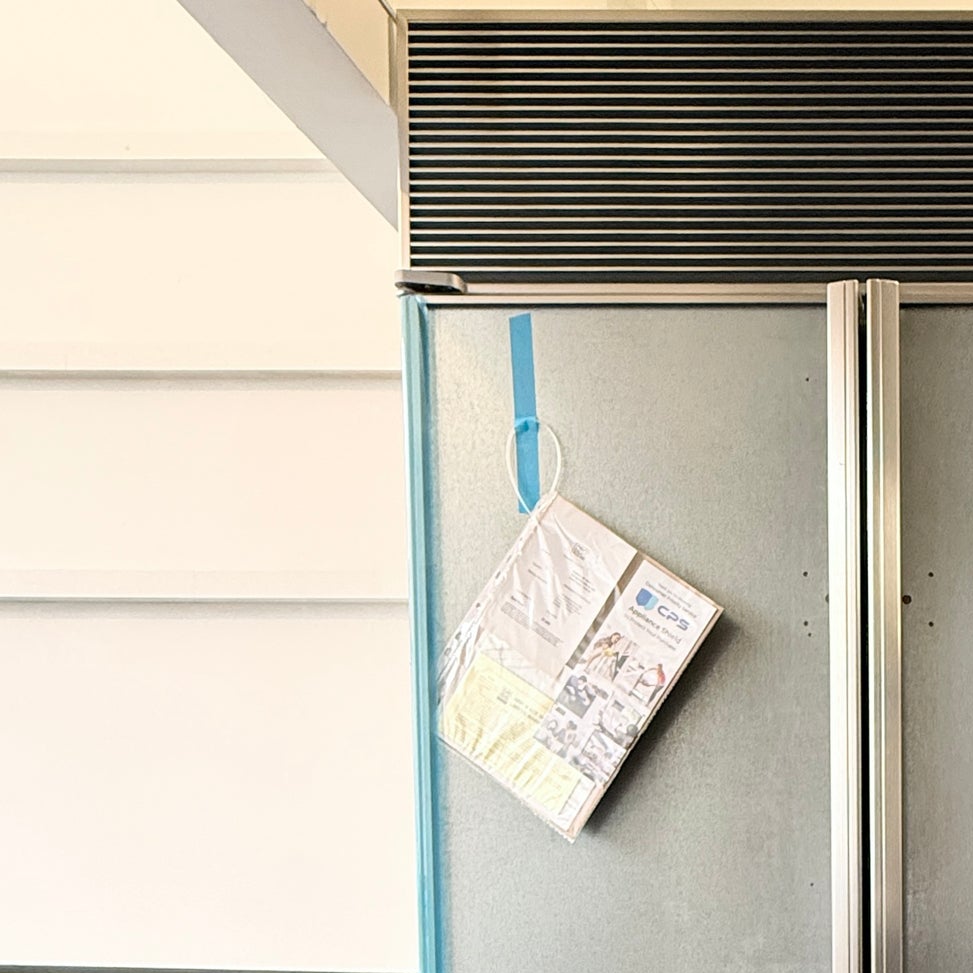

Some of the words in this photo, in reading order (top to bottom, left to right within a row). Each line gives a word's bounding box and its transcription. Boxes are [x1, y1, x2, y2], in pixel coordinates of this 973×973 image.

[628, 606, 661, 630] Appliance
[661, 626, 682, 645] Shield
[657, 605, 690, 631] CPS
